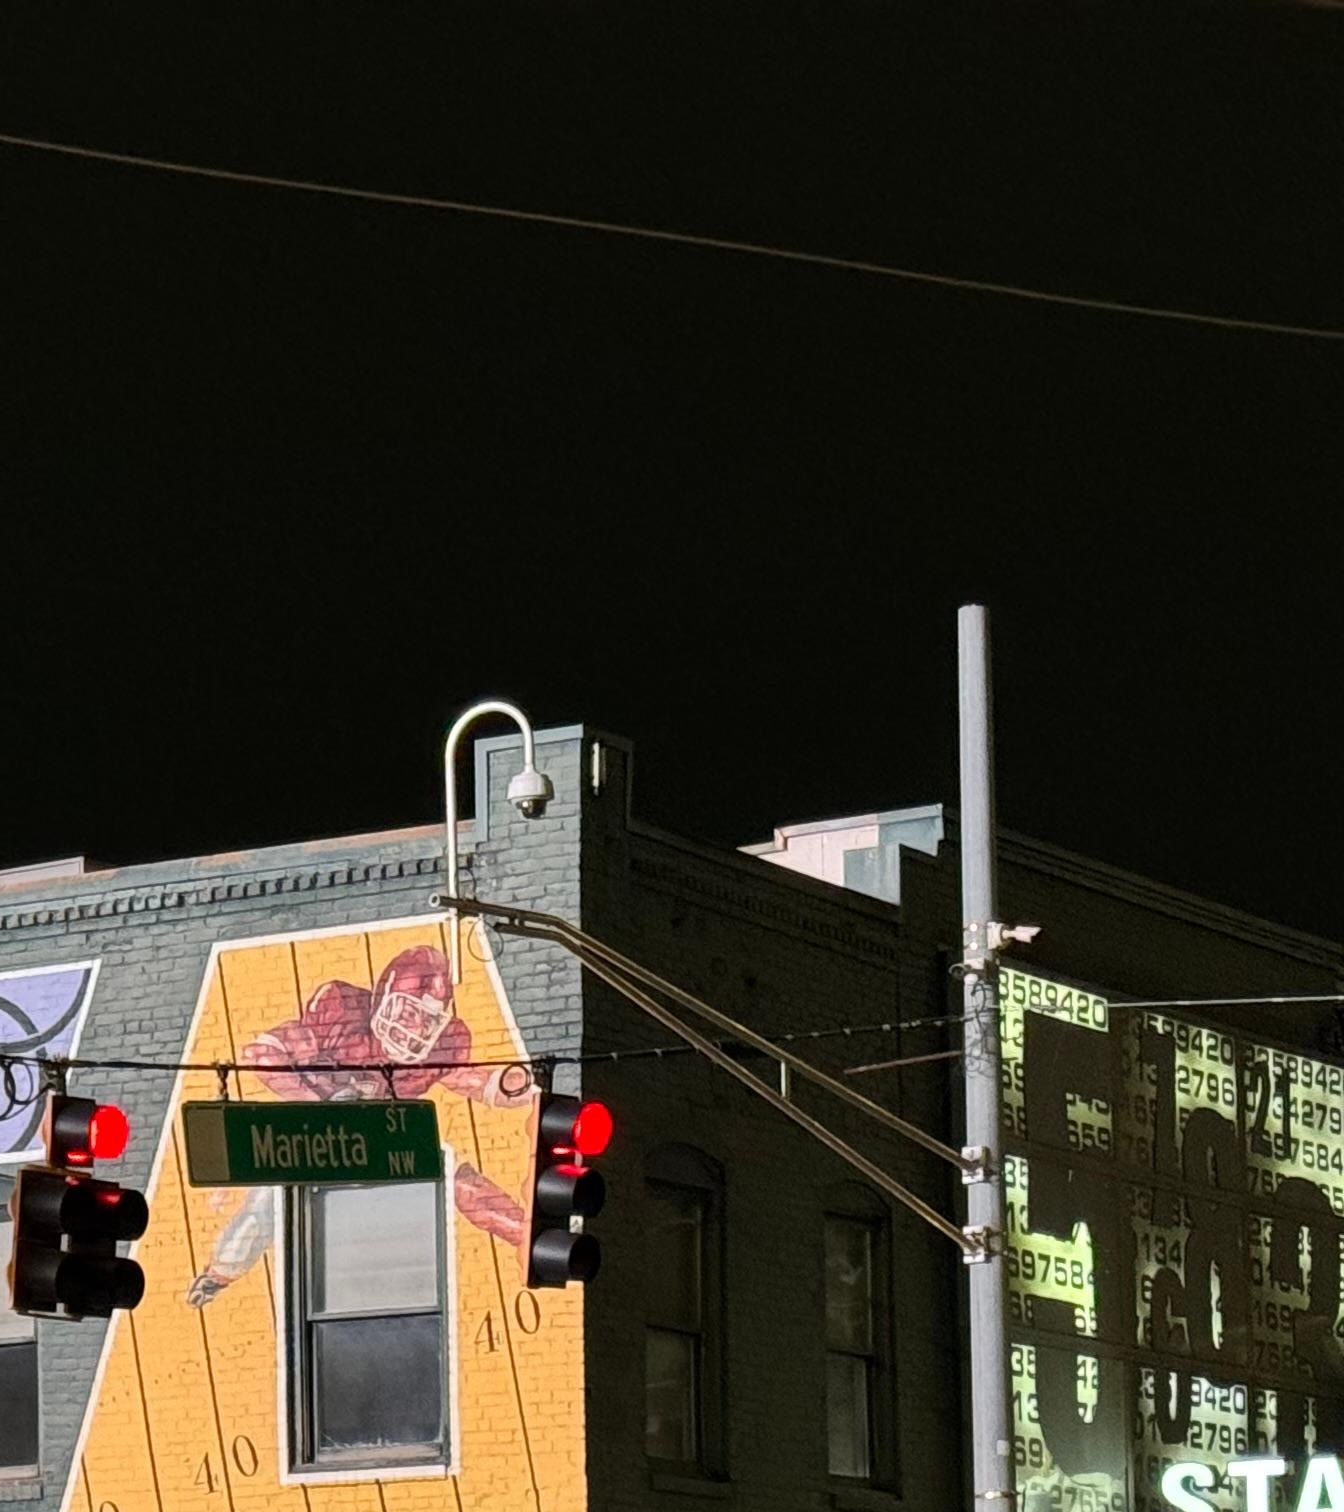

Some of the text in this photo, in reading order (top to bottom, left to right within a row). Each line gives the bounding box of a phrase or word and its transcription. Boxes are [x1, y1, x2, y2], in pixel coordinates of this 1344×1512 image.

[1177, 1064, 1235, 1107] 2796
[250, 1107, 408, 1169] Marietta ST
[387, 1150, 416, 1176] NW
[473, 1288, 542, 1355] 40
[1190, 1420, 1248, 1455] 2796
[193, 1434, 259, 1496] 40
